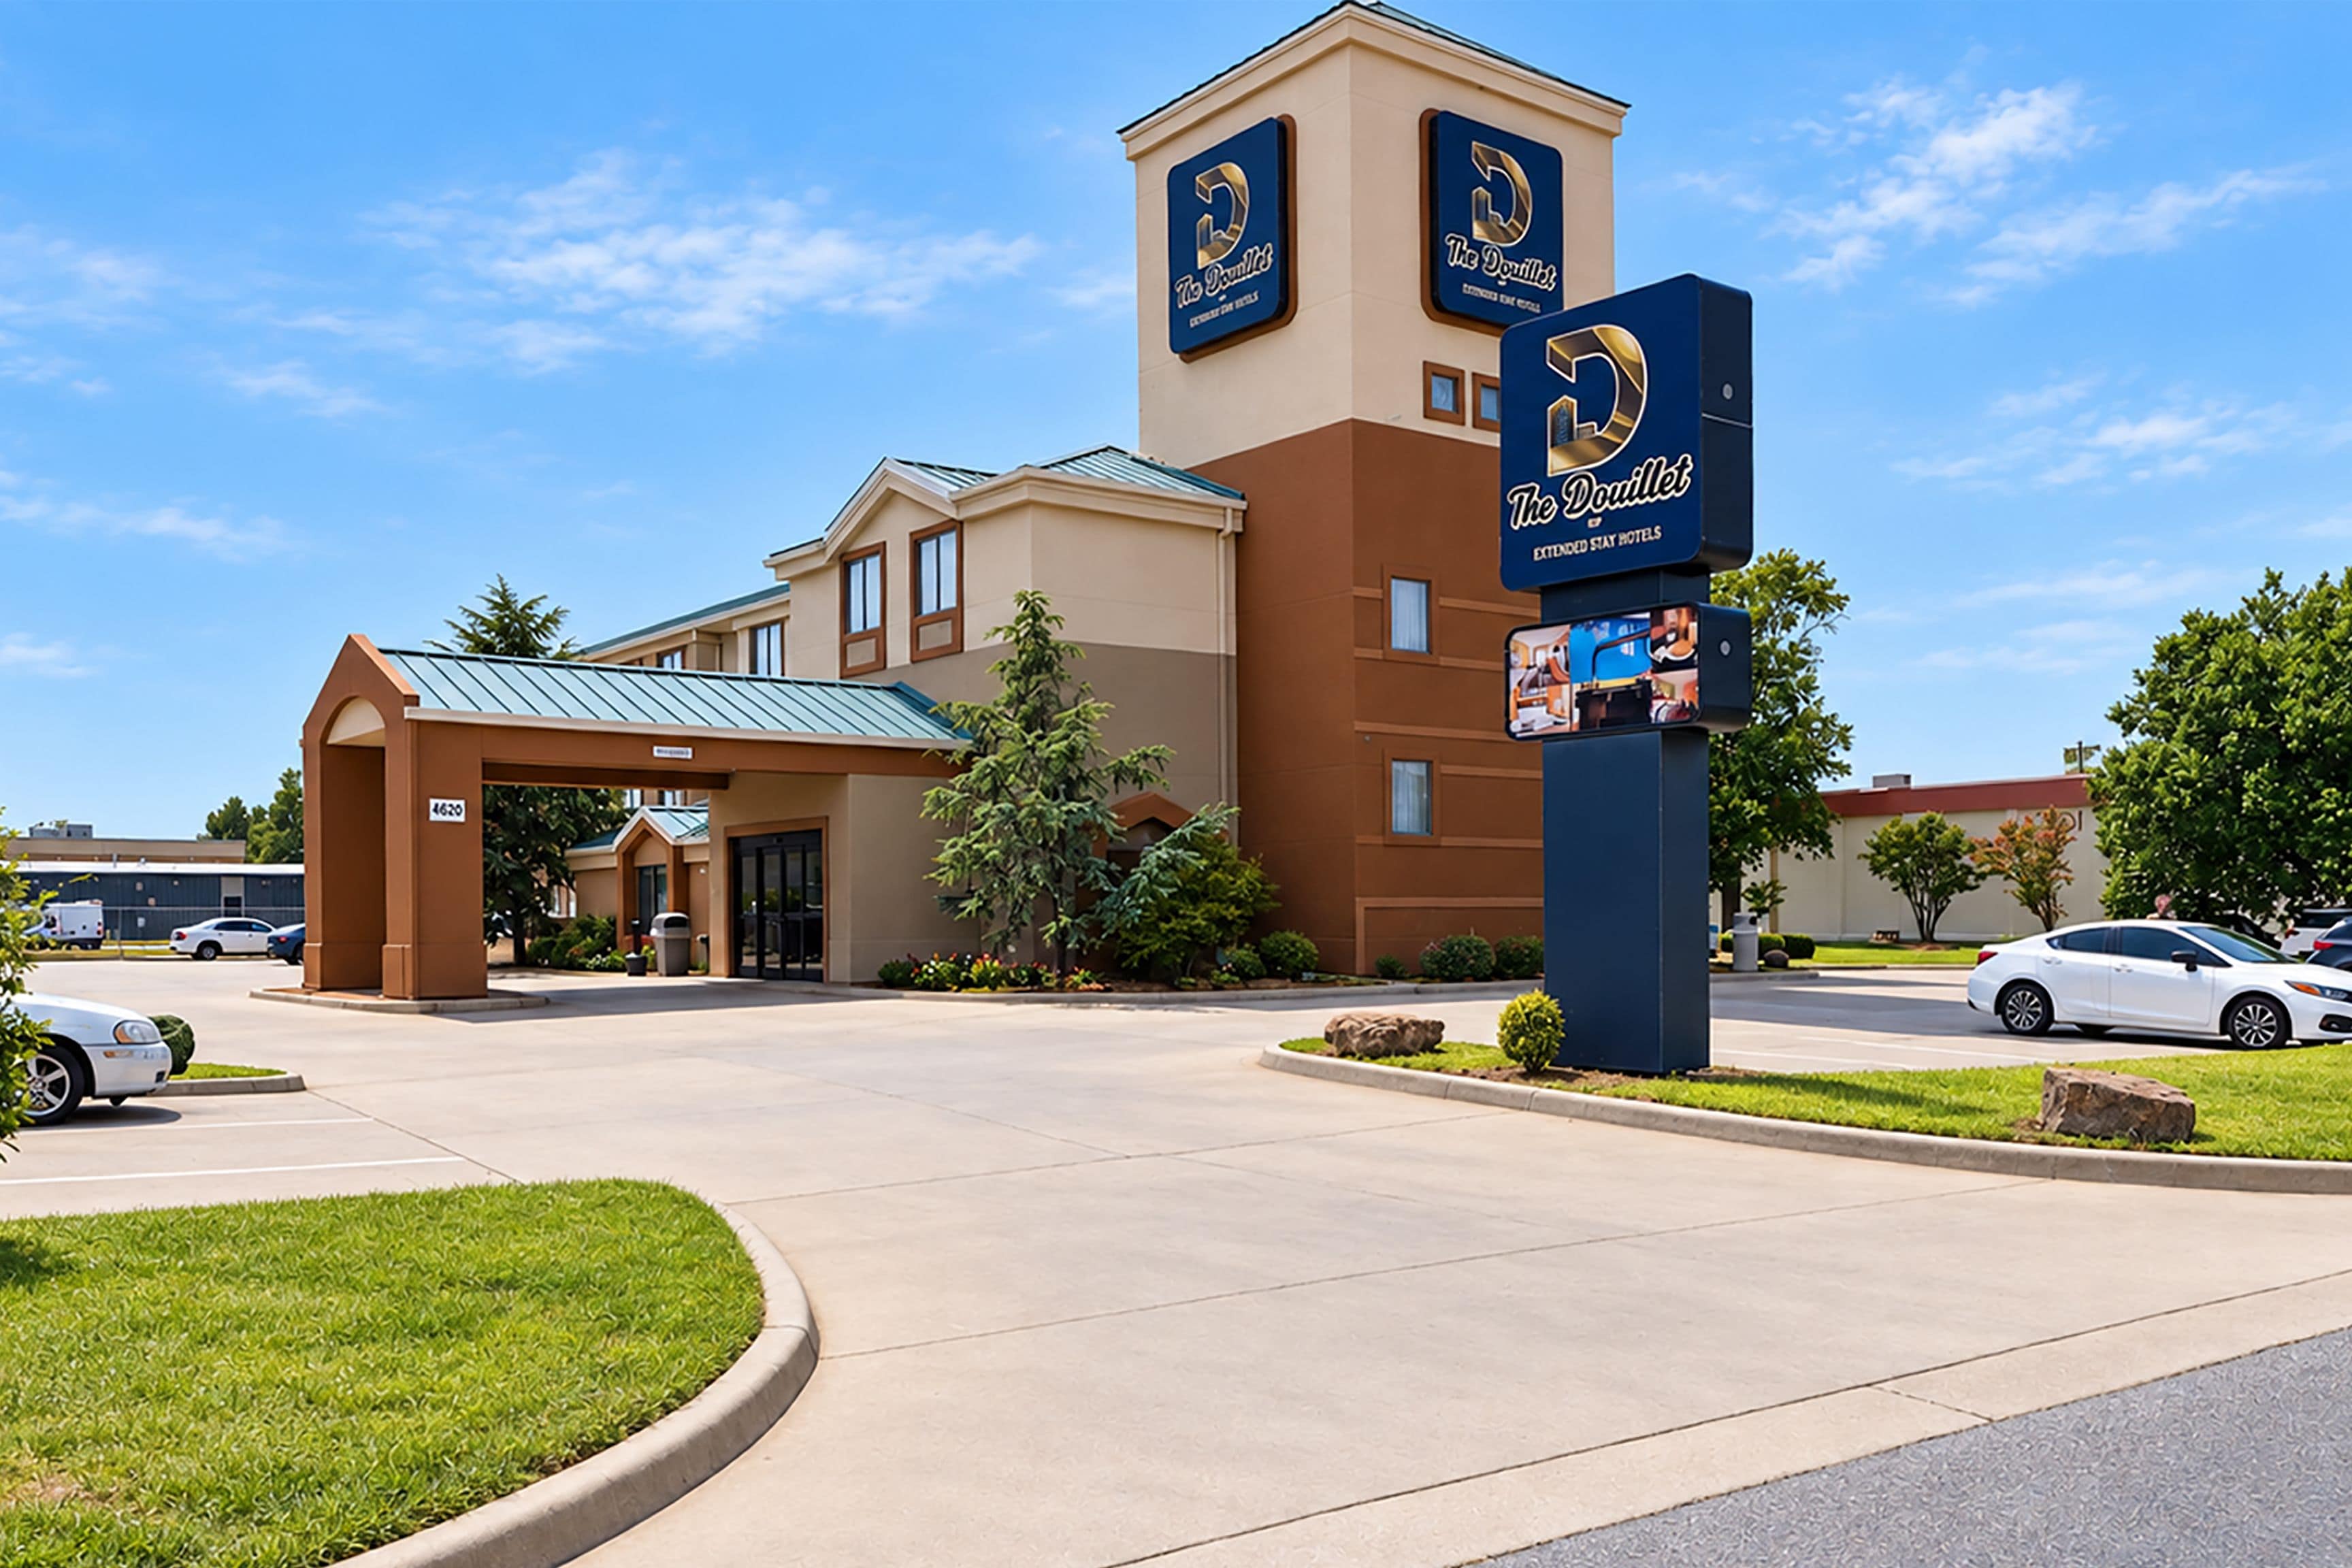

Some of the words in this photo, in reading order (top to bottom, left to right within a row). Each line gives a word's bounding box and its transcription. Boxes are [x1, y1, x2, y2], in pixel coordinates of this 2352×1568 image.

[1445, 233, 1479, 270] The
[1507, 483, 1558, 530] The
[1562, 454, 1693, 519] Douillet
[1533, 540, 1588, 561] EXTENDED
[1590, 534, 1616, 551] STAY
[1618, 525, 1662, 546] HOTELS
[432, 802, 463, 817] 4620
